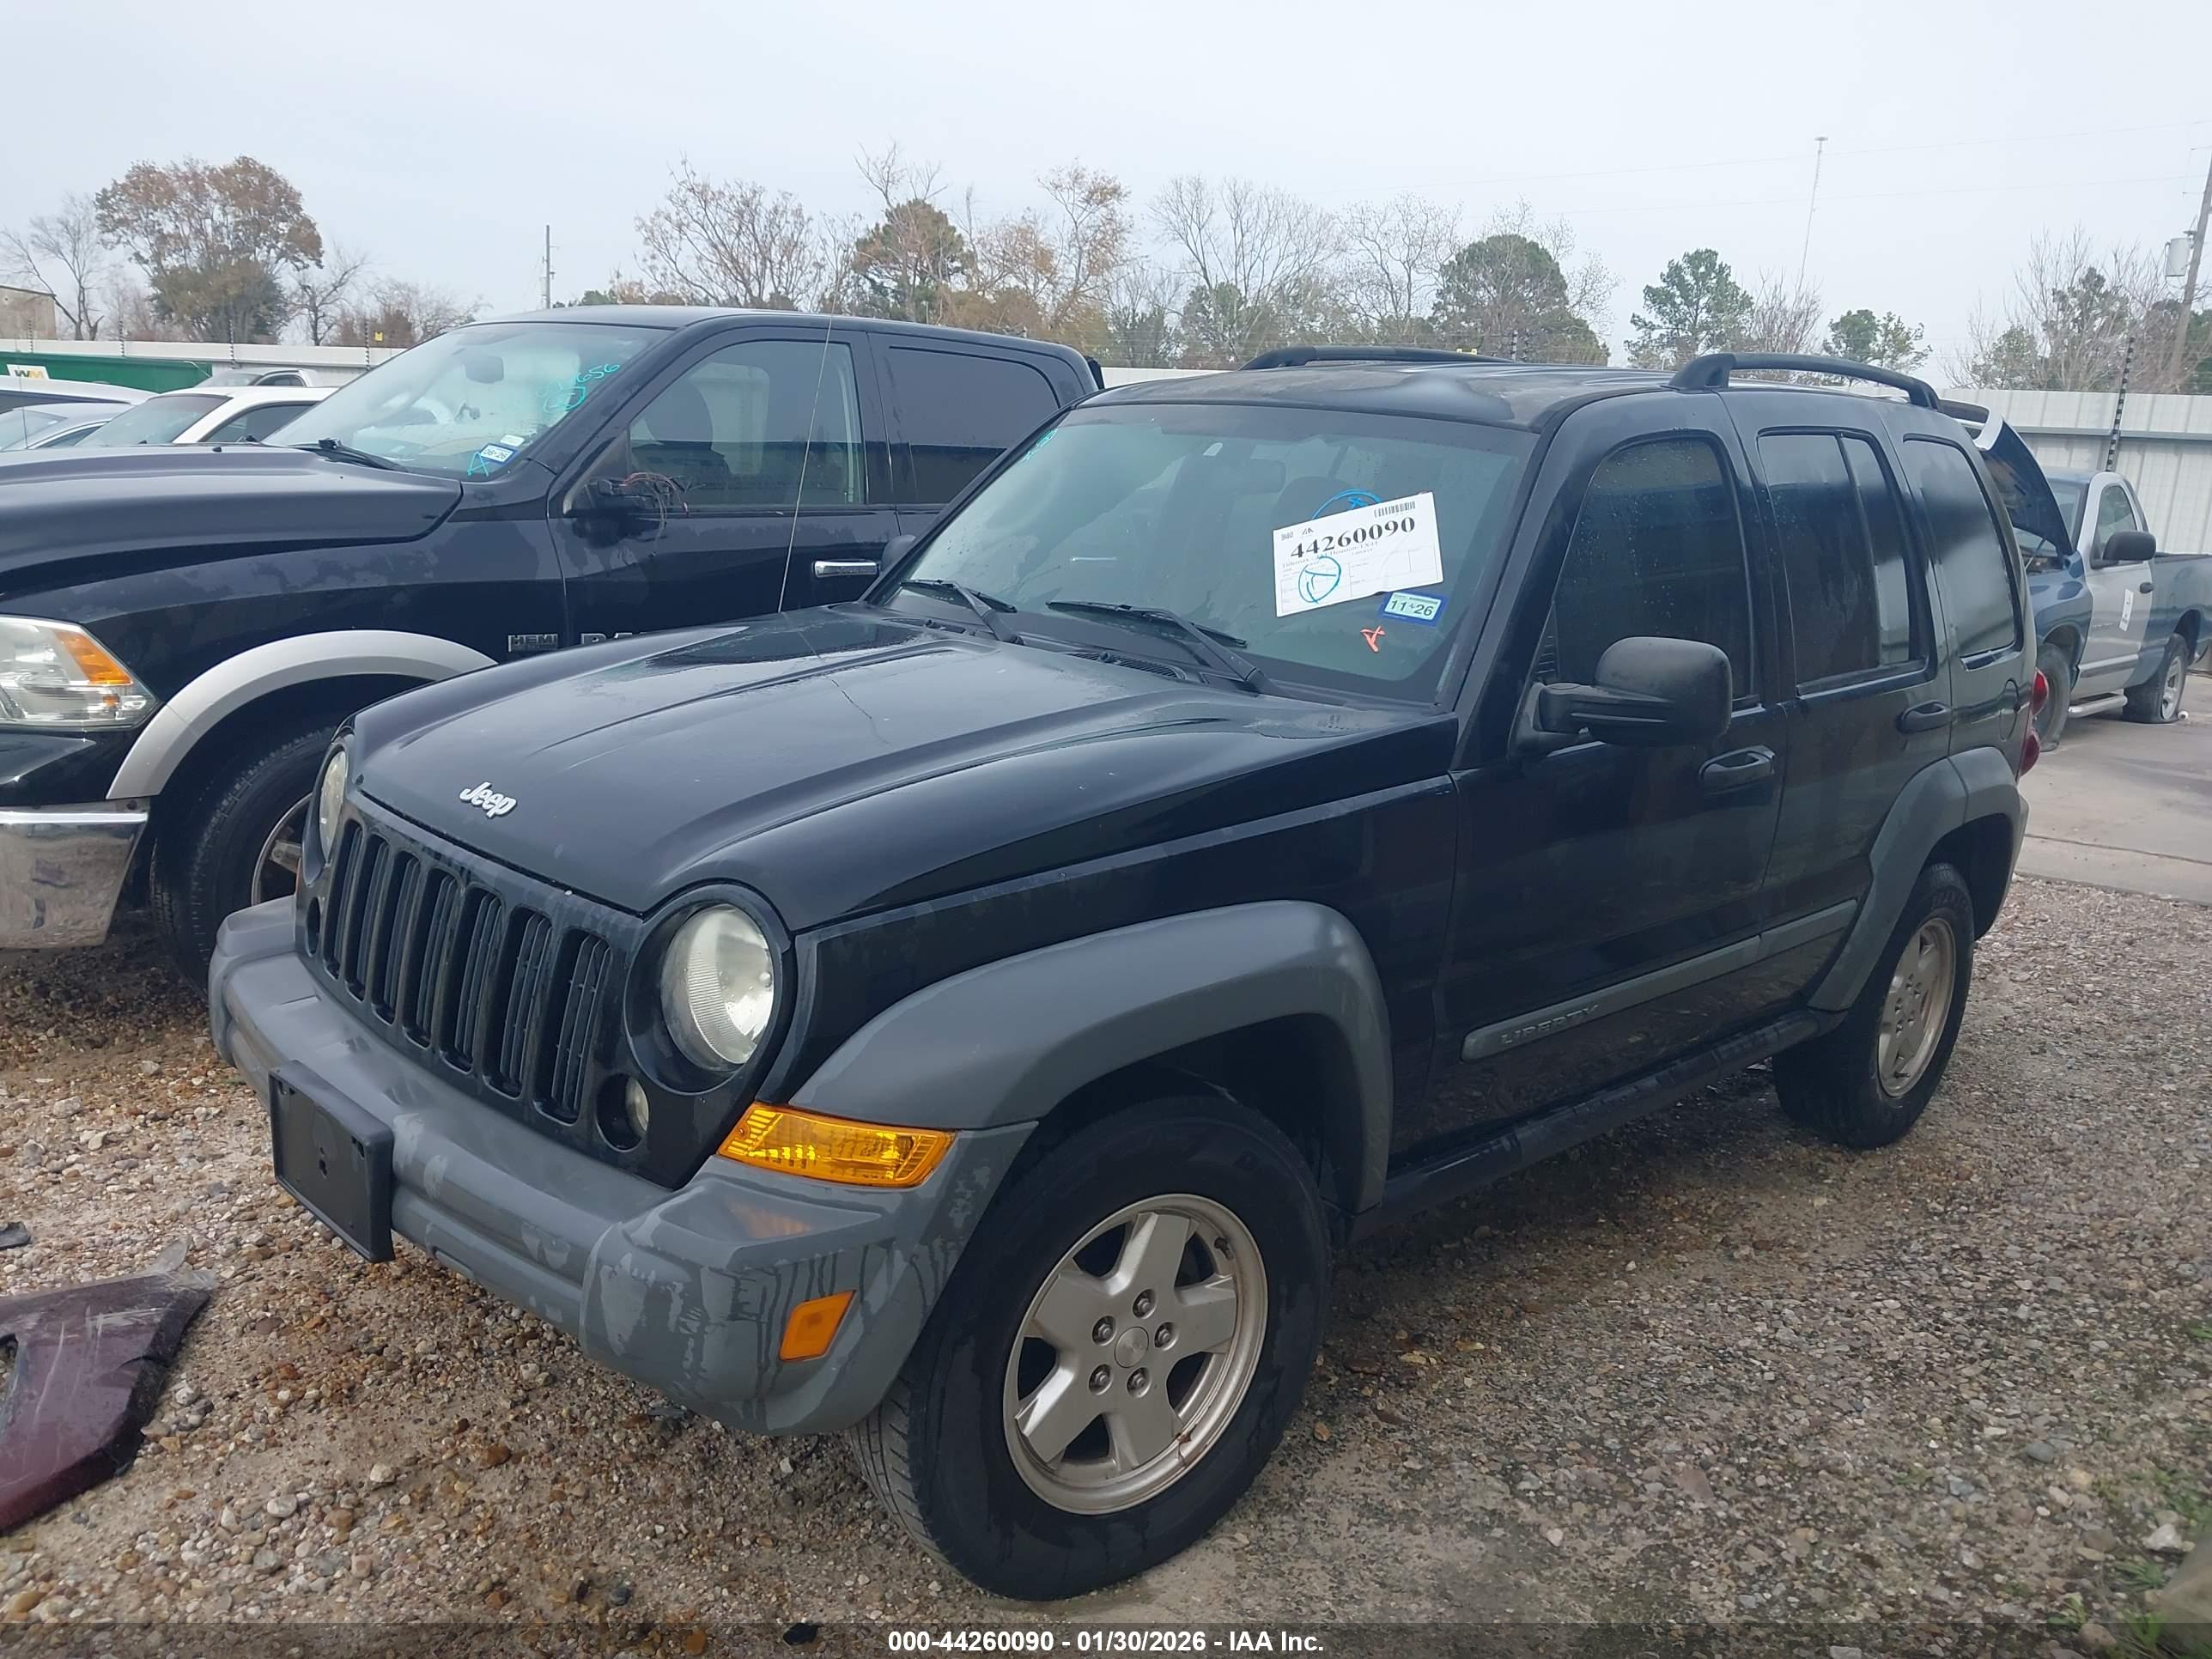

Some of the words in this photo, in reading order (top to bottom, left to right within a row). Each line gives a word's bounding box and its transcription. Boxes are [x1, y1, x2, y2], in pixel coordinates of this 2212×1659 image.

[14, 369, 45, 379] WM
[1290, 517, 1415, 558] 44260090
[507, 633, 558, 648] HEMI
[459, 781, 518, 819] Jeep
[1501, 1004, 1599, 1044] LIBERTY
